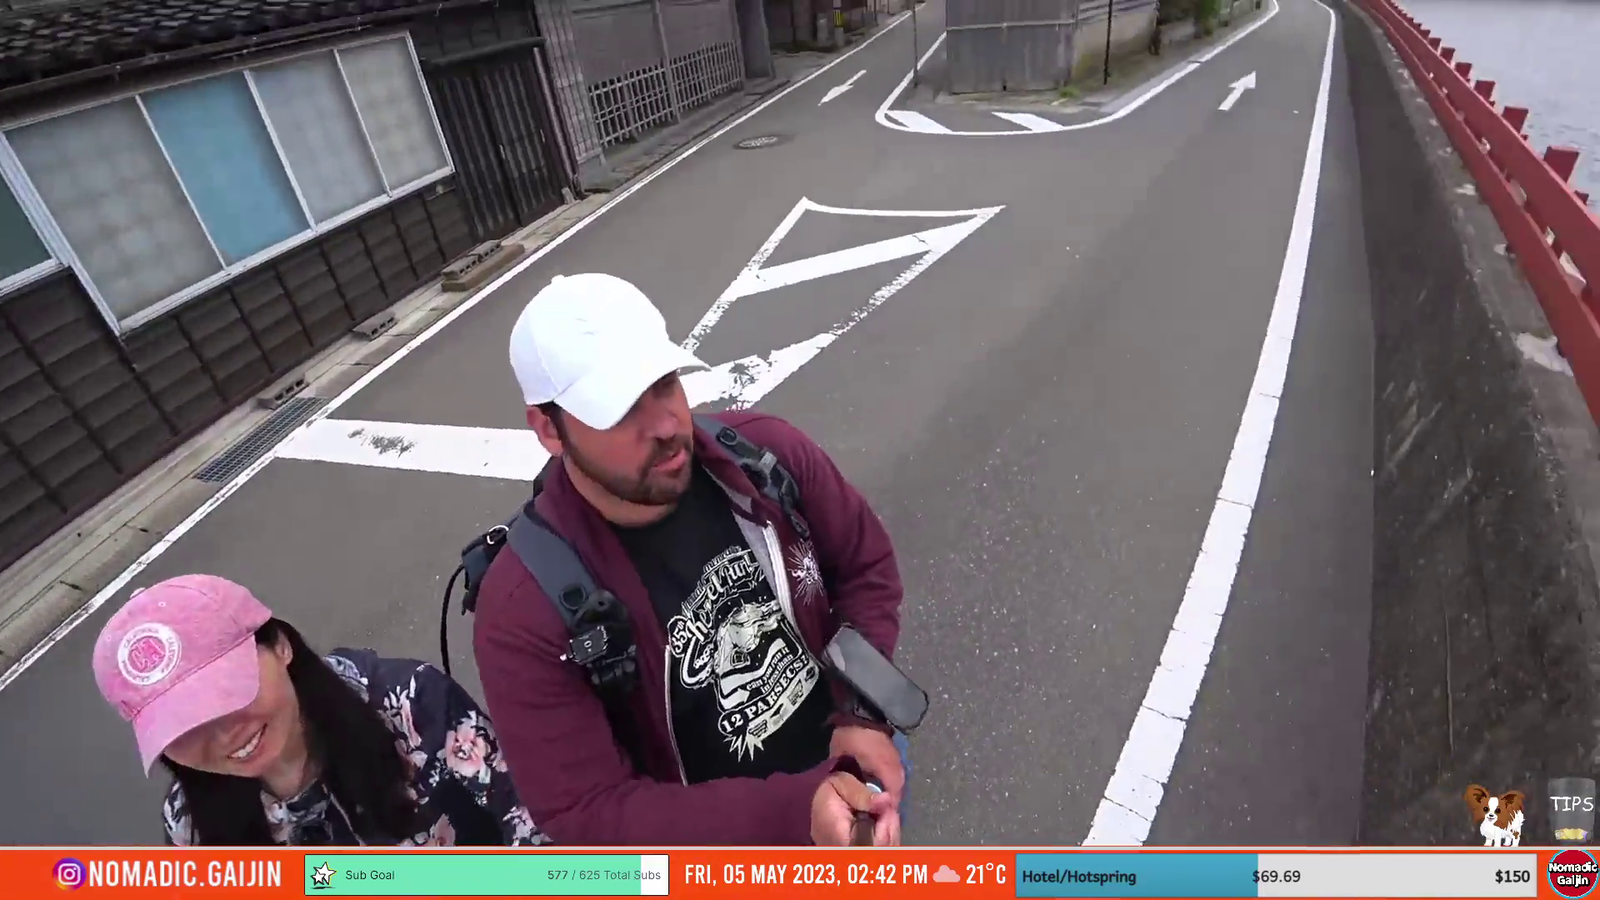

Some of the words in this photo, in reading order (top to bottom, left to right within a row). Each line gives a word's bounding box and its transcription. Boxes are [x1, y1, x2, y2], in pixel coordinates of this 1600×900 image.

[721, 713, 744, 733] 12
[744, 655, 808, 719] PARSECS?
[746, 679, 764, 691] can
